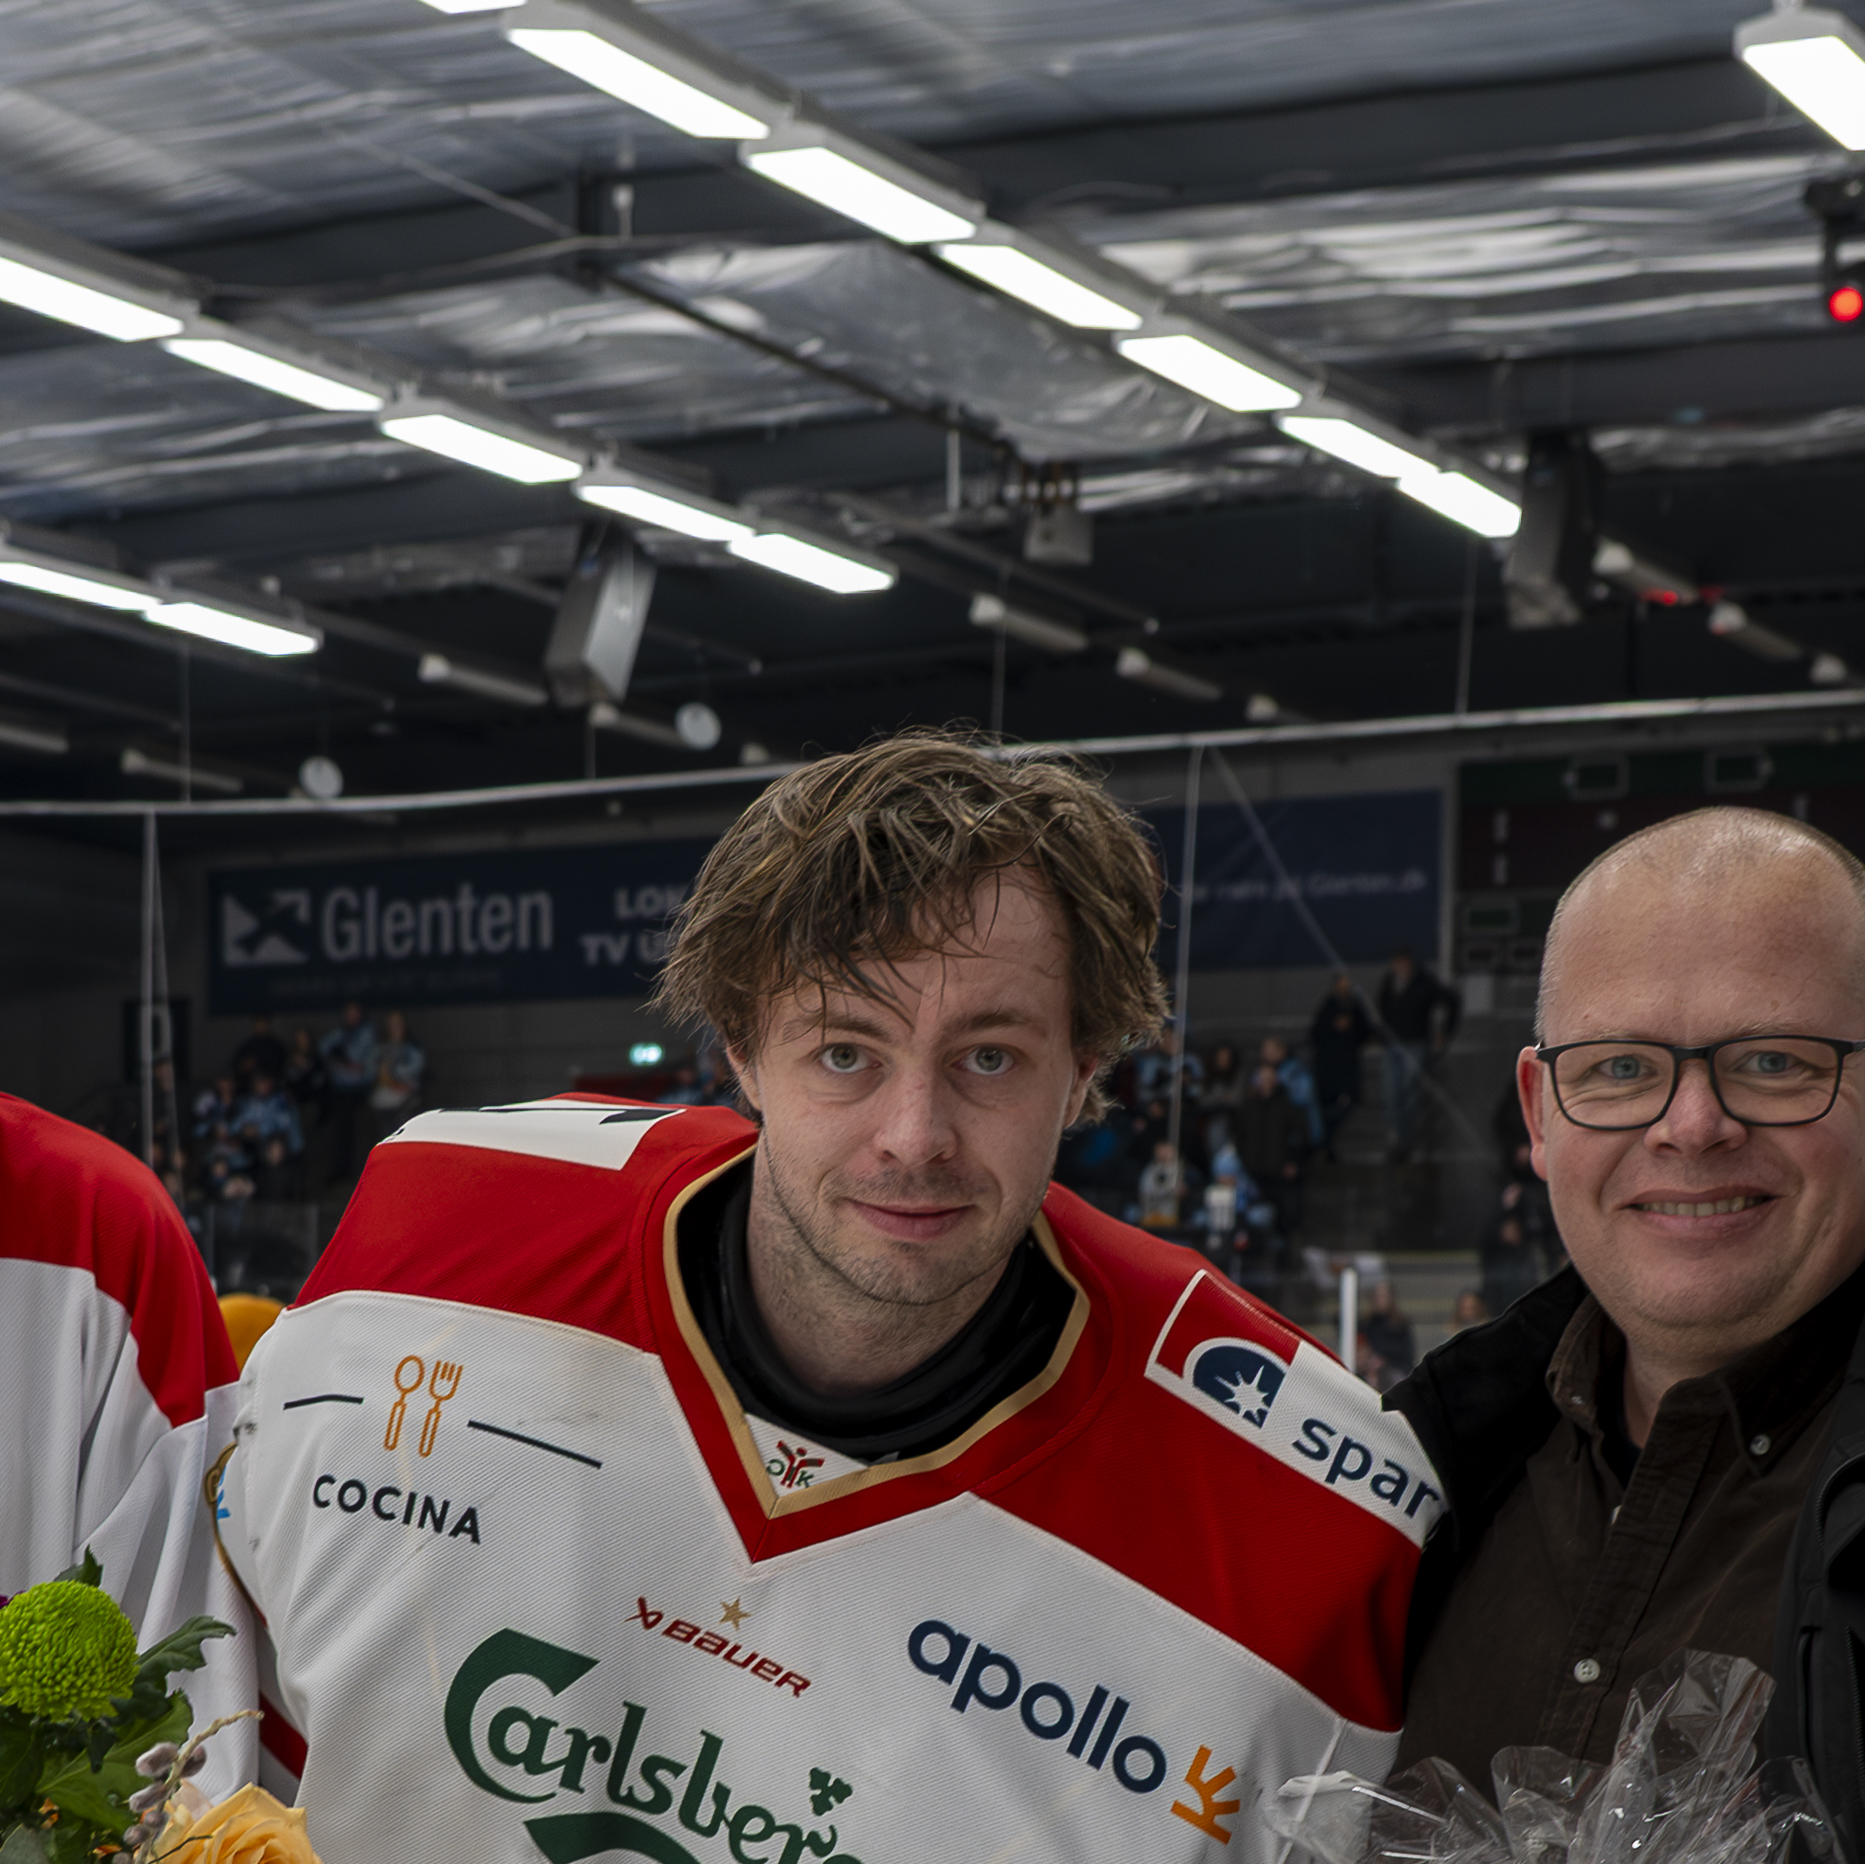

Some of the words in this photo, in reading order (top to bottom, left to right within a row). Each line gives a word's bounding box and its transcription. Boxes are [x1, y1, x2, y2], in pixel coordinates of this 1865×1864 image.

[320, 882, 553, 963] Glenten
[579, 931, 633, 967] TV
[313, 1473, 481, 1544] COCINA
[907, 1618, 1167, 1793] apollo
